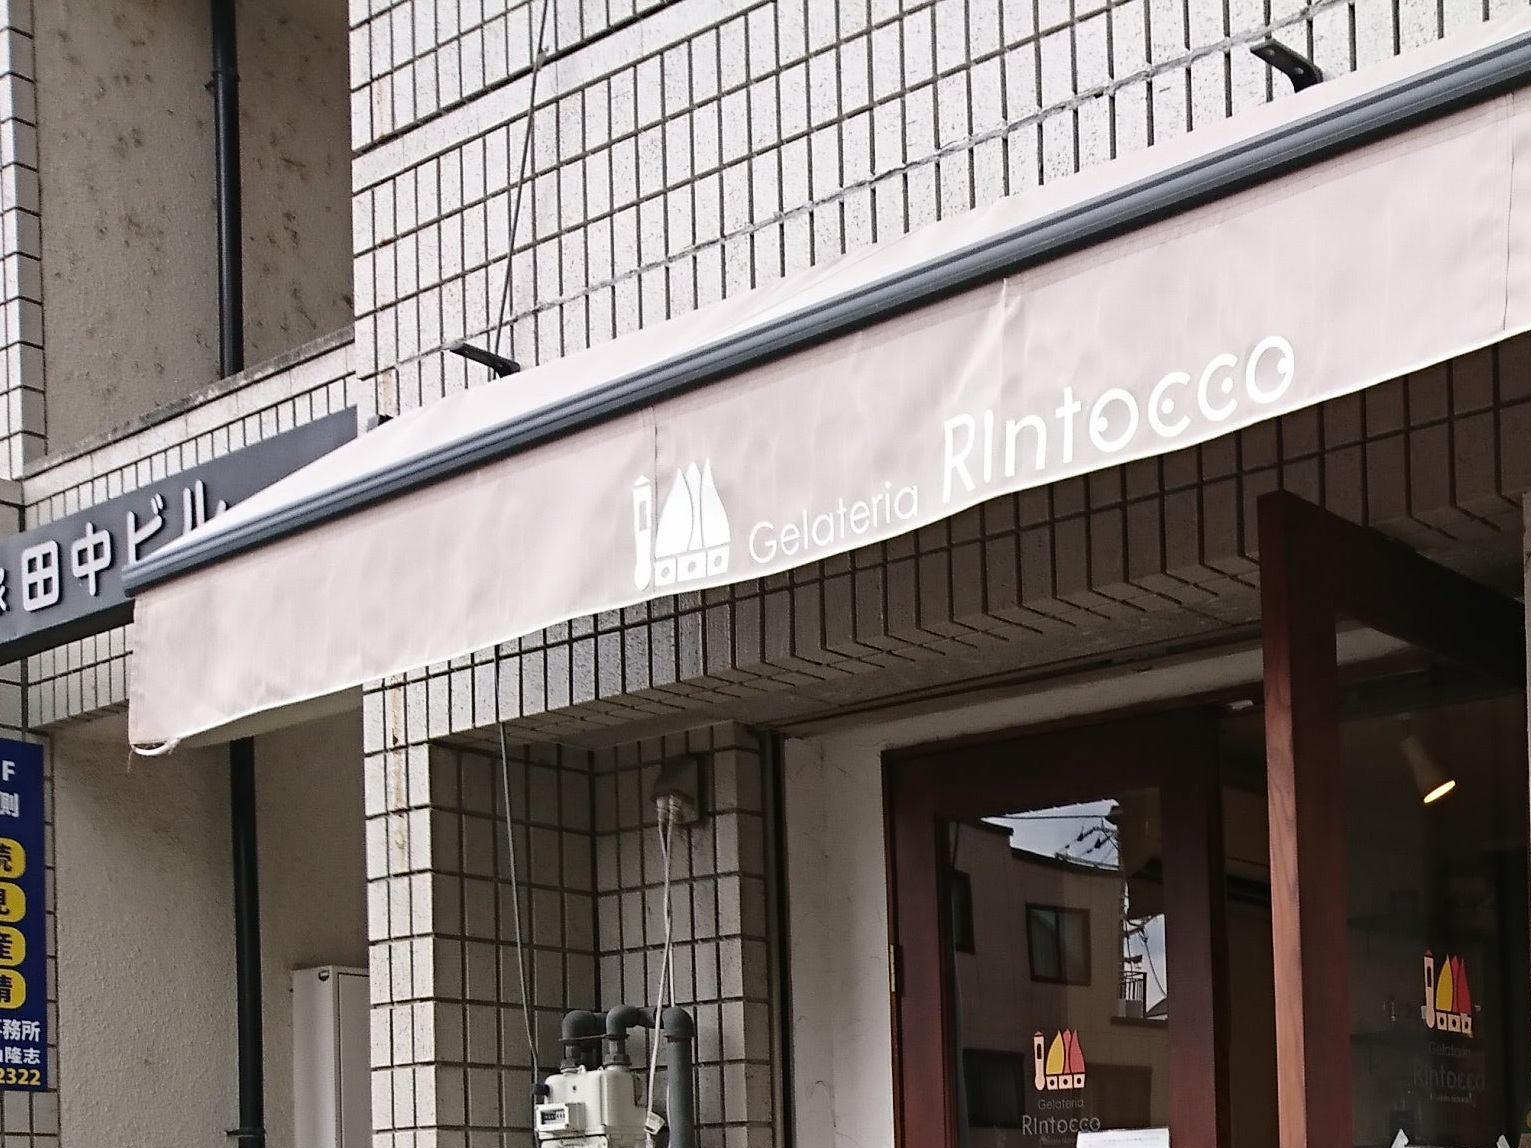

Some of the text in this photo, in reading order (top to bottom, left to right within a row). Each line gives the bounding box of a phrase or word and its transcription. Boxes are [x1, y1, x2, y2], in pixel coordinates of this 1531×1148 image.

[750, 479, 918, 563] Gelateria
[0, 1019, 41, 1042] 務所
[0, 1047, 41, 1064] 隆志
[1037, 1098, 1084, 1110] Gelateria
